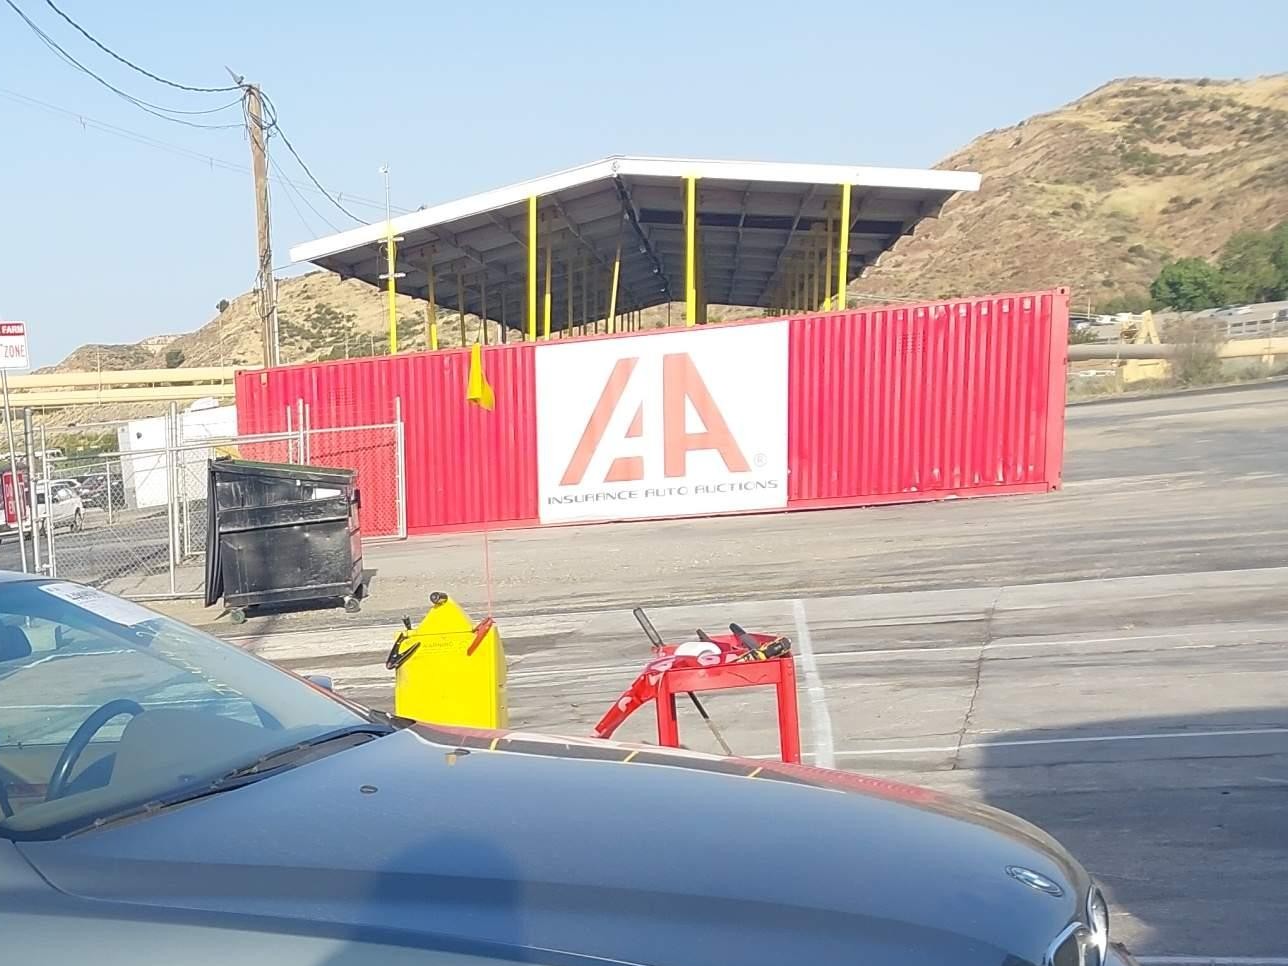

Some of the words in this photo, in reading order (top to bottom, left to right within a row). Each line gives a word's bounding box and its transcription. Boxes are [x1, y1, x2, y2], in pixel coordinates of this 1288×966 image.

[1, 325, 24, 334] FARM
[4, 344, 25, 358] ZONE
[547, 490, 638, 505] INSURANCE
[644, 486, 688, 498] AUTO
[694, 479, 779, 495] AUCTIONS
